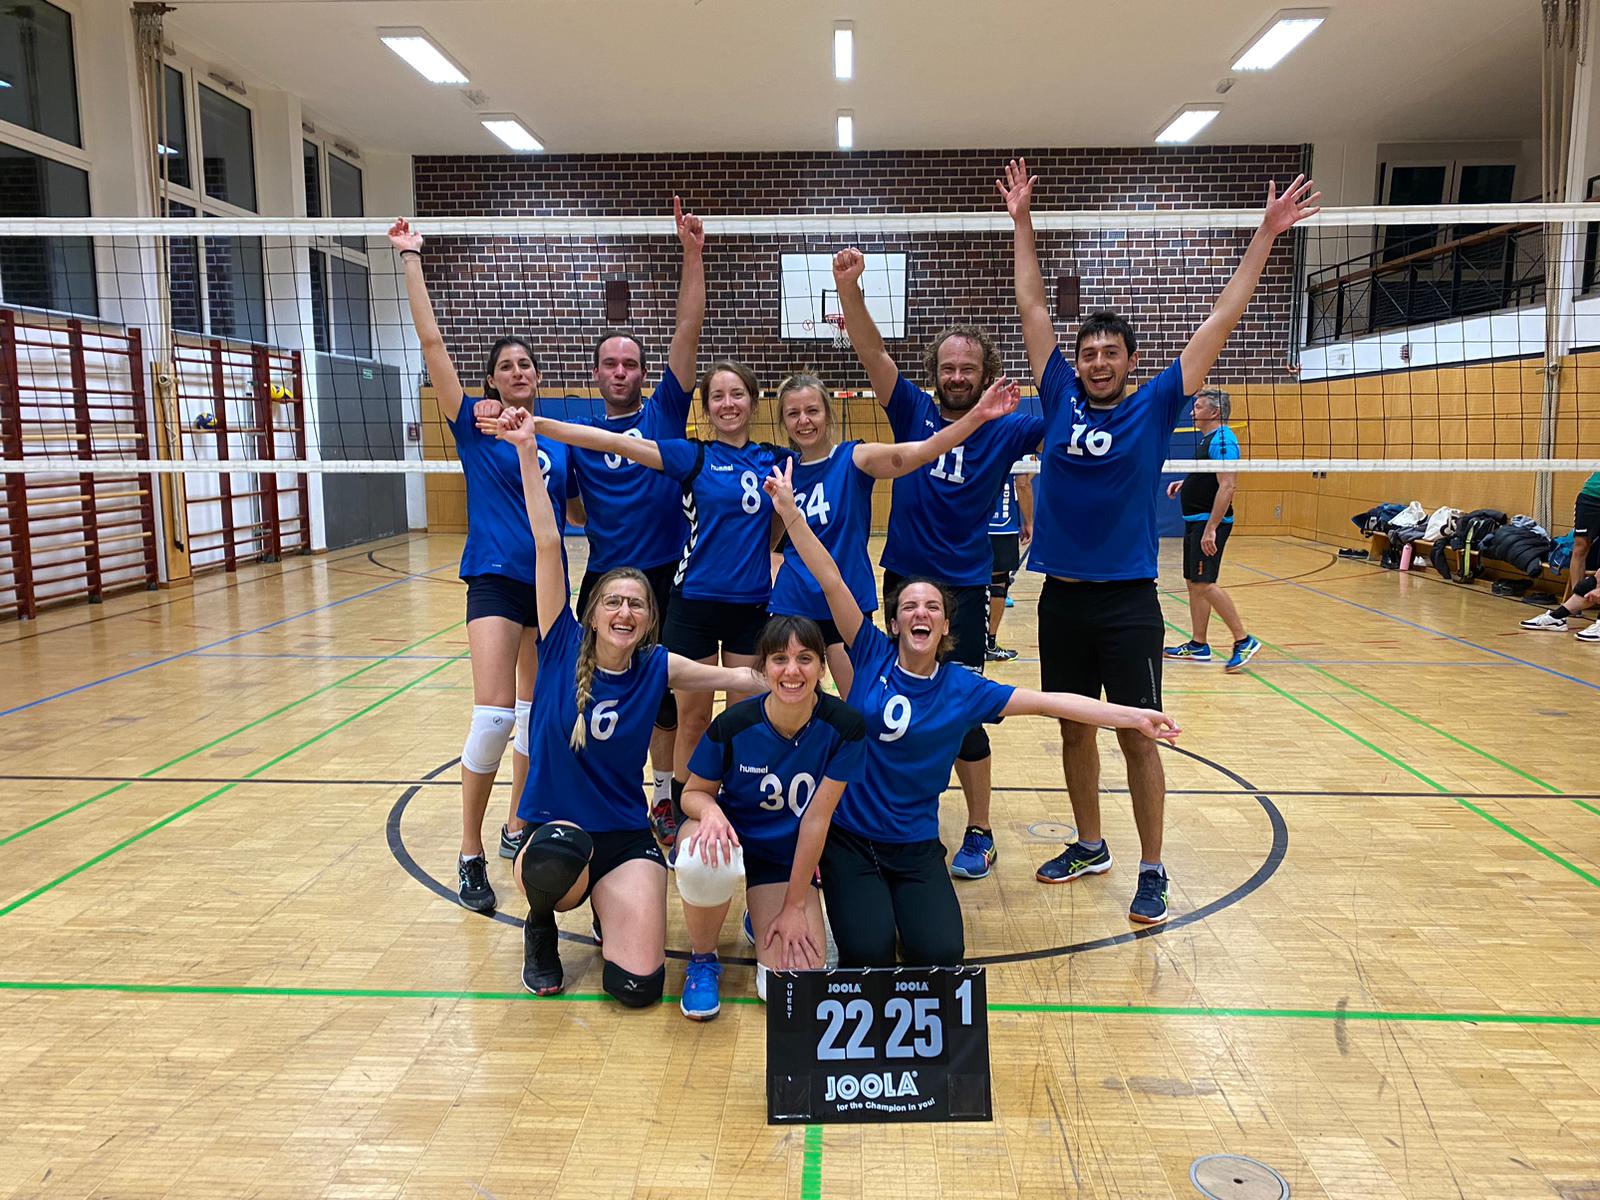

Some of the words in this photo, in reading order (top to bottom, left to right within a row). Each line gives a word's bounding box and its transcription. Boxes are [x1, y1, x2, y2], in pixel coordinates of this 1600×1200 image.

[1067, 424, 1112, 456] 16
[740, 470, 761, 514] 8
[590, 700, 619, 741] 6
[878, 694, 912, 742] 9
[739, 763, 768, 774] hummel
[759, 772, 816, 818] 30
[828, 983, 861, 993] JOOLA
[895, 981, 929, 992] JOOLA
[955, 979, 972, 1025] 1
[816, 999, 875, 1060] 22
[884, 997, 943, 1058] 25
[825, 1071, 919, 1101] JOOLA
[836, 1103, 848, 1112] for
[849, 1101, 863, 1109] the
[865, 1101, 906, 1112] Champion
[908, 1103, 916, 1111] in
[918, 1097, 935, 1110] you!
